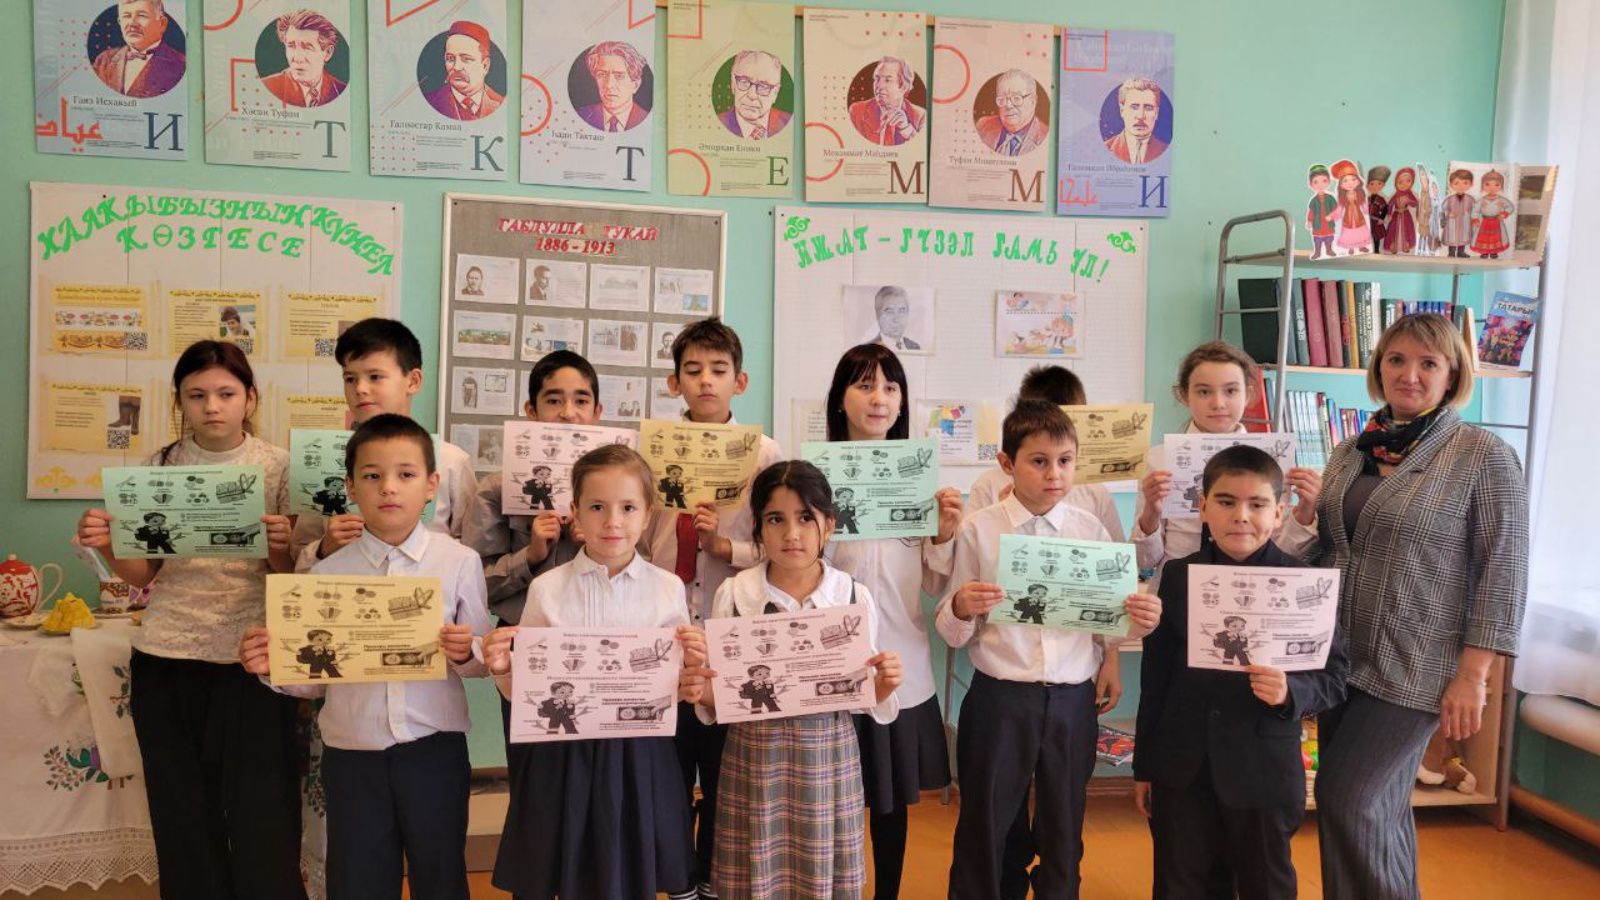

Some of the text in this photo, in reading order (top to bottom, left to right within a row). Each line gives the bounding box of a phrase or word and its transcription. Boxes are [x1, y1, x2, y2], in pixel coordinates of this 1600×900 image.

[144, 112, 183, 151] И
[470, 135, 504, 172] К
[766, 156, 790, 186] Е
[887, 161, 925, 195] М
[1007, 169, 1045, 203] М
[1138, 175, 1168, 208] И
[536, 237, 569, 252] 1886
[582, 240, 615, 255] 1913
